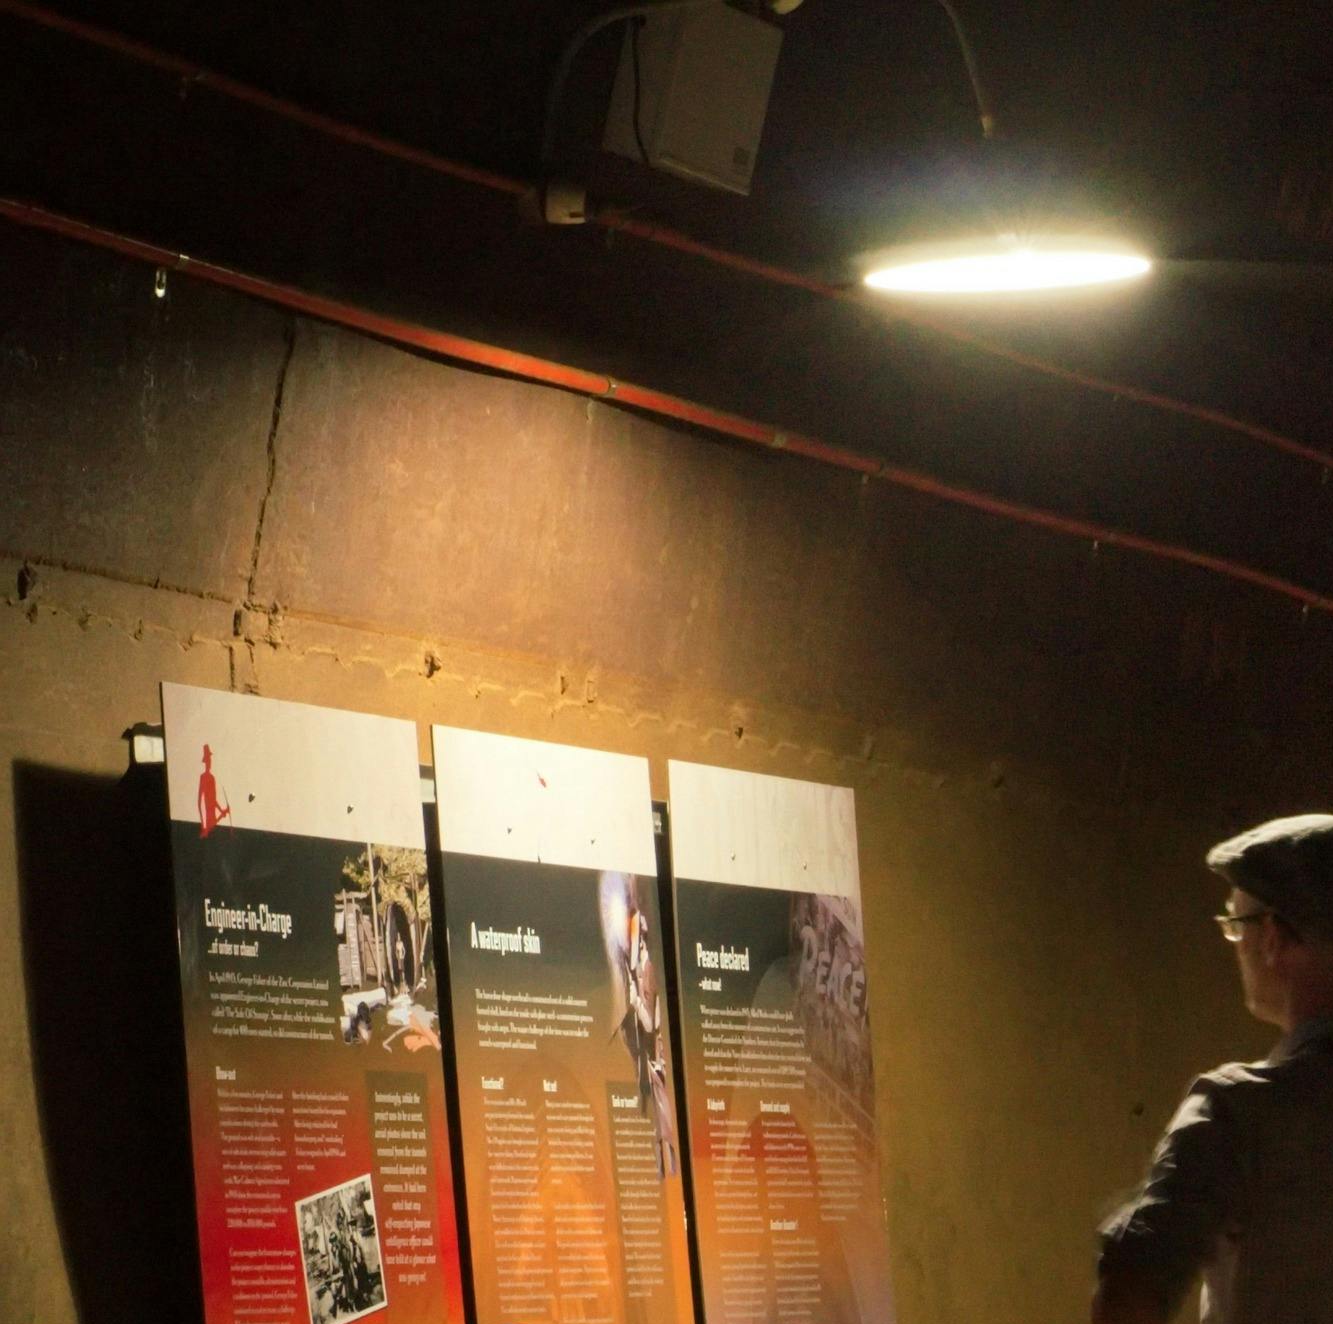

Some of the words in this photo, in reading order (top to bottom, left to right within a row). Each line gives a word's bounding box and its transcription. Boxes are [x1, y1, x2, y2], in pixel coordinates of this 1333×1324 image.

[204, 898, 292, 939] Engineer-in-Charge
[471, 921, 479, 949] A
[478, 926, 522, 956] waterproof
[523, 927, 541, 954] skin
[696, 942, 719, 969] Peace
[719, 944, 750, 972] declared
